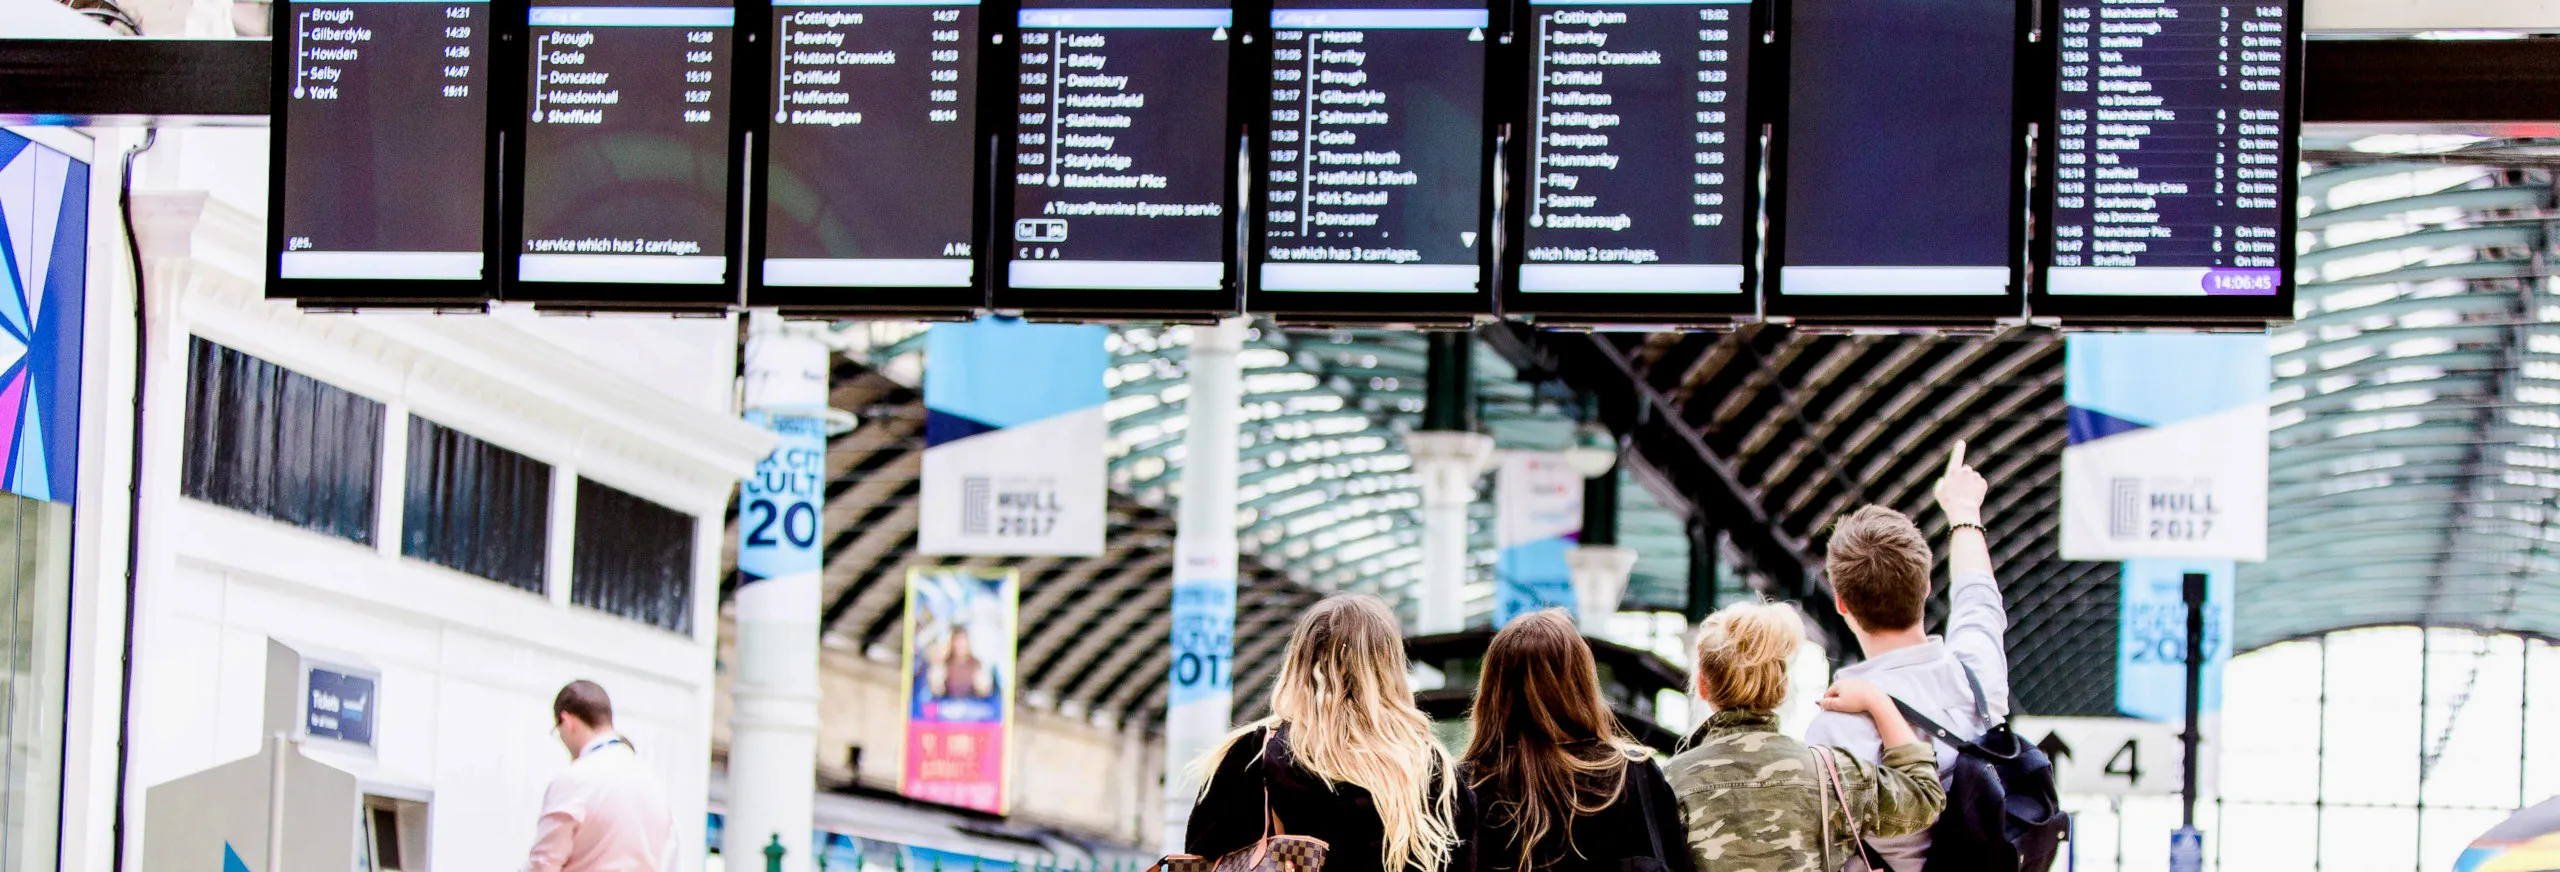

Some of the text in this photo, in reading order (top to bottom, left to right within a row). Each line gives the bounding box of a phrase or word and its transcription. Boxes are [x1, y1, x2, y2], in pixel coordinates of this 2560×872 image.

[312, 6, 471, 25] Brough 14:21
[794, 10, 864, 28] Cottingham
[1553, 8, 1729, 27] Cottingham 15:02
[2100, 6, 2158, 19] Manchester
[2156, 6, 2179, 18] Picc
[311, 26, 471, 44] Gilberdyke 14:29
[2099, 20, 2283, 36] Scarborough On time
[550, 30, 595, 48] Brough
[793, 30, 846, 48] Beverley
[1068, 32, 1106, 48] Leeds
[1322, 30, 1364, 44] Hessle
[1552, 30, 1608, 48] Beverley
[2099, 35, 2282, 48] Sheffield On time
[310, 45, 471, 61] Howden 14:36
[548, 50, 586, 65] Goole
[793, 49, 896, 65] Hutton Cranswick
[1321, 49, 1367, 66] Ferriby
[1552, 50, 1662, 65] Hutton Cranswick
[2099, 50, 2282, 63] York On time
[1067, 52, 1107, 71] Batley
[309, 65, 470, 83] Selby 14:47
[548, 70, 712, 85] Doncaster 15:19
[792, 69, 841, 85] Driffield
[1320, 69, 1367, 87] Brough
[1551, 70, 1603, 86] Driffield
[2098, 64, 2281, 77] Sheffield On time
[1067, 73, 1129, 91] Dewsbury
[2098, 79, 2281, 94] Bridlington On time
[309, 85, 469, 100] York 15:11
[548, 89, 619, 105] Meadowhall
[792, 89, 850, 105] Nafferton
[1066, 93, 1144, 108] Huddersfield
[1319, 89, 1386, 107] Gilberdyke
[1550, 90, 1727, 106] Nafferton 15:27
[2097, 94, 2165, 107] via Doncaster
[547, 108, 603, 125] Sheffield
[791, 109, 862, 128] Bridlington
[1065, 113, 1132, 128] Slaithwaite
[1319, 109, 1389, 125] Saltmarshe
[1550, 111, 1620, 130] Bridlington
[2097, 108, 2280, 121] Manchester Picc On time
[1318, 130, 1357, 145] Goole
[2096, 123, 2280, 138] Bridlington On time
[1064, 133, 1115, 151] Mossley
[1549, 132, 1609, 149] Bempton
[2096, 137, 2279, 150] Sheffield On time
[1064, 153, 1133, 171] Stalybridge
[1317, 150, 1401, 165] Thorne North
[1548, 152, 1620, 170] Hunmanby
[2095, 152, 2279, 165] York On time
[1063, 173, 1167, 189] Manchester Picc
[1316, 170, 1379, 186] Hatfield &
[2095, 166, 2278, 180] Sheffield On time
[1548, 172, 1579, 191] Filey
[2094, 181, 2278, 194] London Cross On time
[1316, 190, 1389, 206] Kirk Sandall
[1547, 193, 1598, 208] Seamer
[2094, 196, 2277, 211] Scarborough On time
[1043, 200, 1185, 219] A TransPennine Express
[2093, 210, 2161, 223] via Doncaster
[1315, 211, 1379, 226] Doncaster
[1546, 213, 1632, 232] Scarborough
[2093, 225, 2277, 238] Manchester Picc On time
[535, 237, 577, 252] service
[576, 236, 612, 252] which
[612, 237, 635, 253] has
[634, 237, 644, 253] 2
[942, 242, 955, 256] A
[2092, 239, 2276, 255] Bridlington On time
[1019, 247, 1060, 259] C A
[1290, 245, 1328, 261] which
[1327, 245, 1352, 261] has
[1352, 246, 1362, 261] 3
[1563, 246, 1588, 262] has
[1587, 246, 1598, 262] 2
[2092, 254, 2275, 267] Sheffield On time
[2214, 274, 2272, 290] 14:06:45
[996, 491, 1063, 511] HULL
[2149, 492, 2221, 514] HULL
[745, 497, 816, 548] 20
[996, 515, 1059, 537] 2017
[2149, 518, 2216, 540] 2017
[2103, 738, 2143, 785] 4
